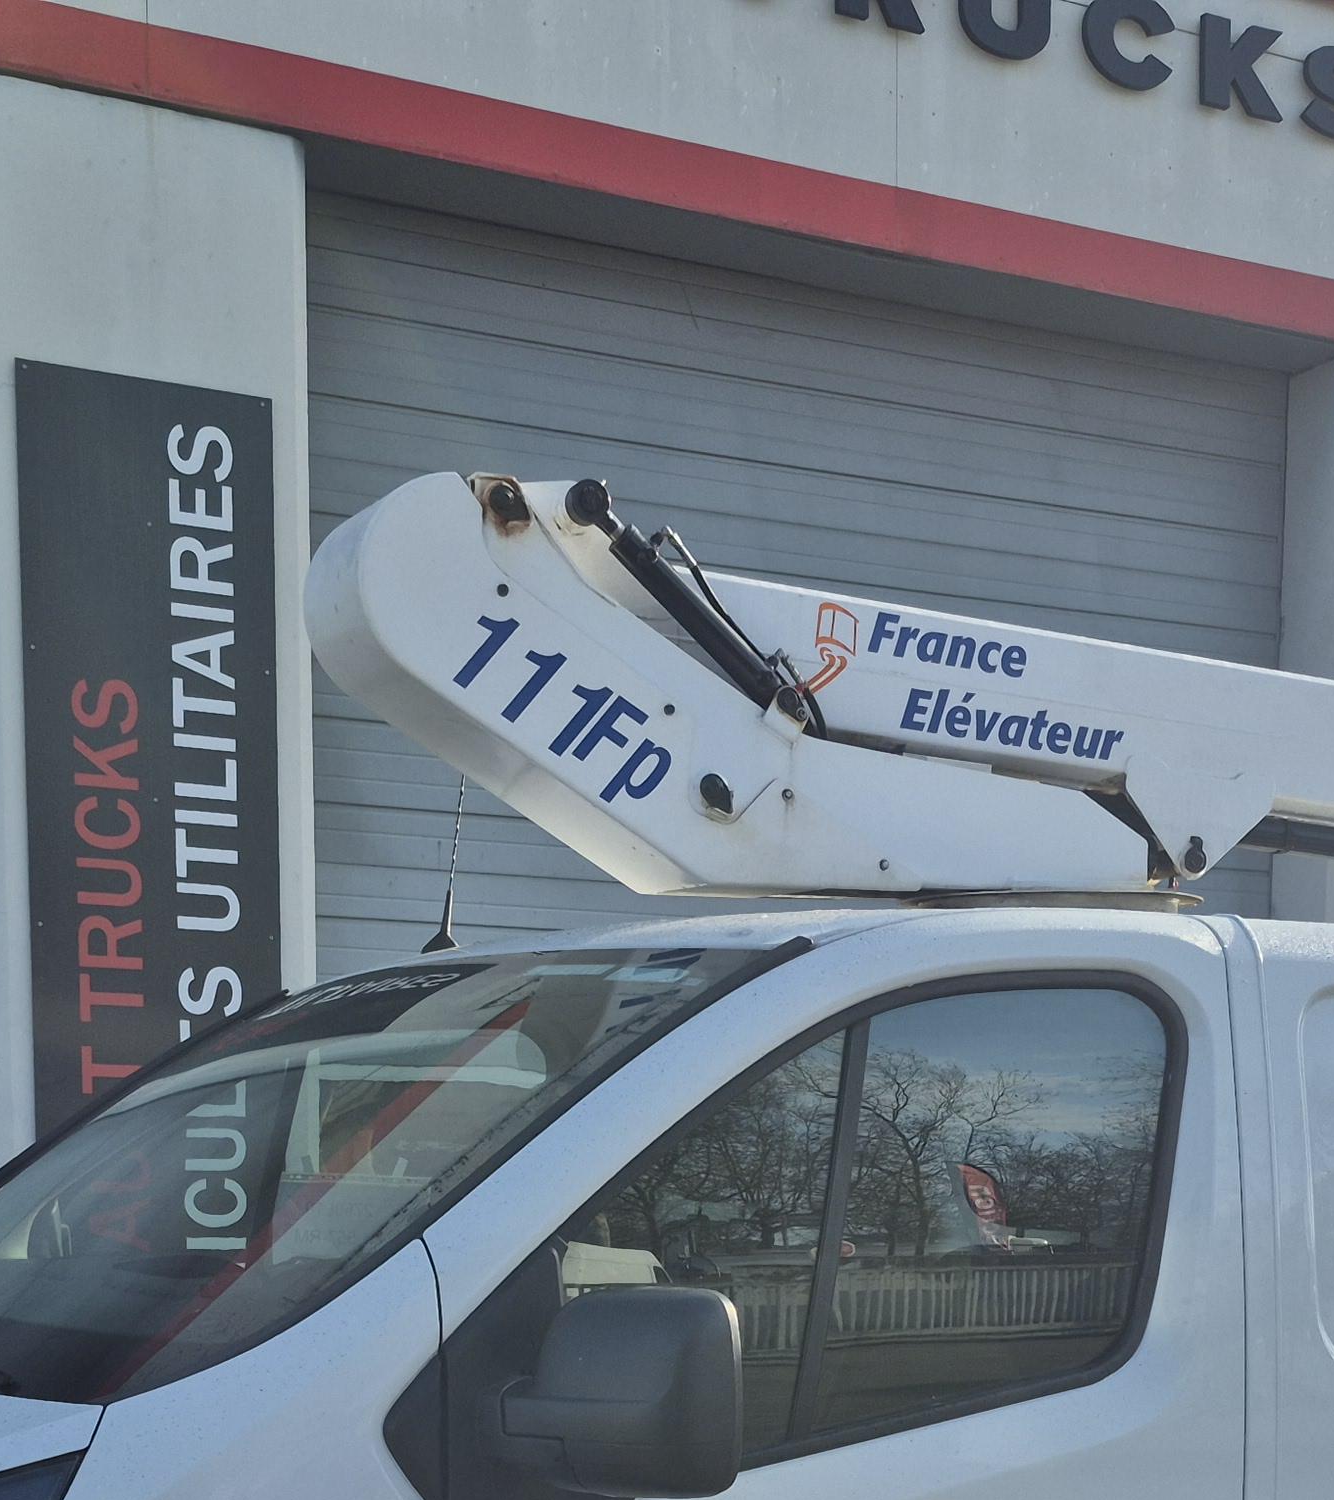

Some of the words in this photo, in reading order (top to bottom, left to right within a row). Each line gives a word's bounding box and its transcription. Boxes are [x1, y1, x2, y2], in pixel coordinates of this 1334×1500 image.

[166, 423, 241, 932] UTILITAIRES
[452, 613, 673, 803] 111Fp
[868, 612, 1027, 679] France
[900, 688, 1125, 761] Elévateur
[71, 678, 145, 1023] TRUCKS
